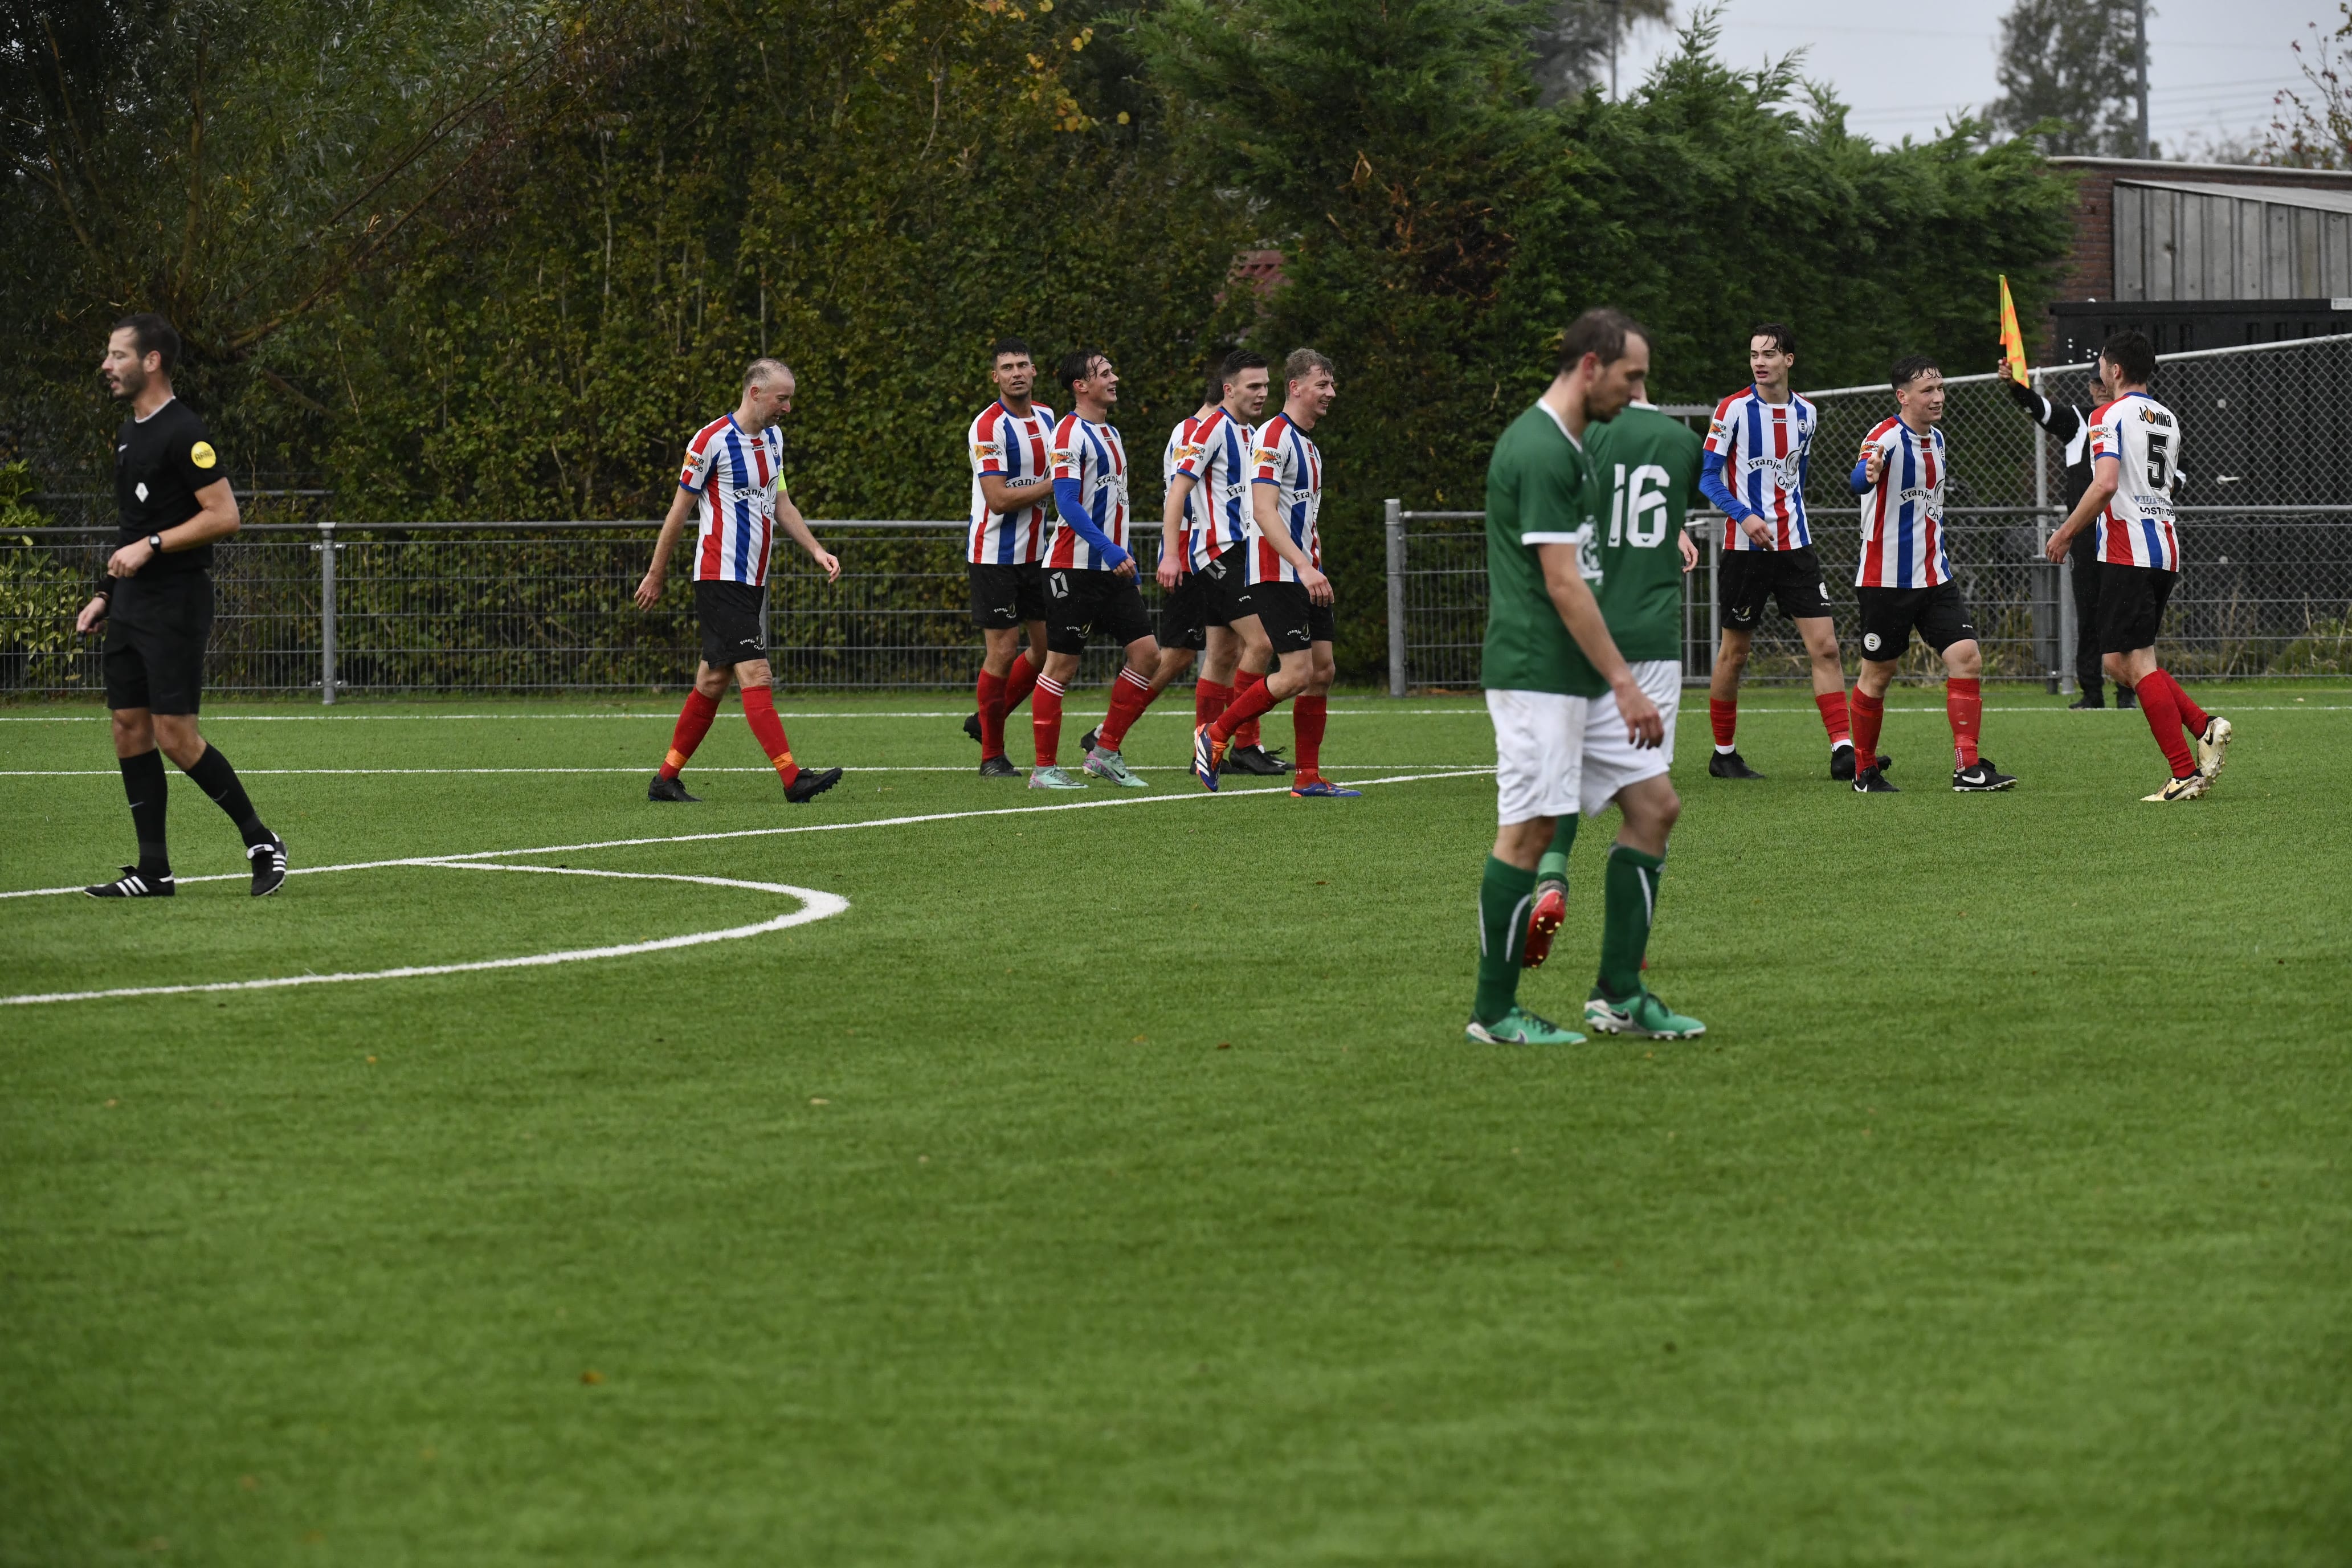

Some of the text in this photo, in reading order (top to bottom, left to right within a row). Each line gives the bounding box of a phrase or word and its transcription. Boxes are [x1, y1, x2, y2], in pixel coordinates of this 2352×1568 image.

[1747, 459, 1781, 470] Franje
[2146, 431, 2169, 491] 5
[1096, 476, 1121, 487] Franje
[733, 488, 765, 500] Franje
[1900, 489, 1932, 501] Franje
[1607, 463, 1670, 548] 16
[763, 505, 774, 519] Oni
